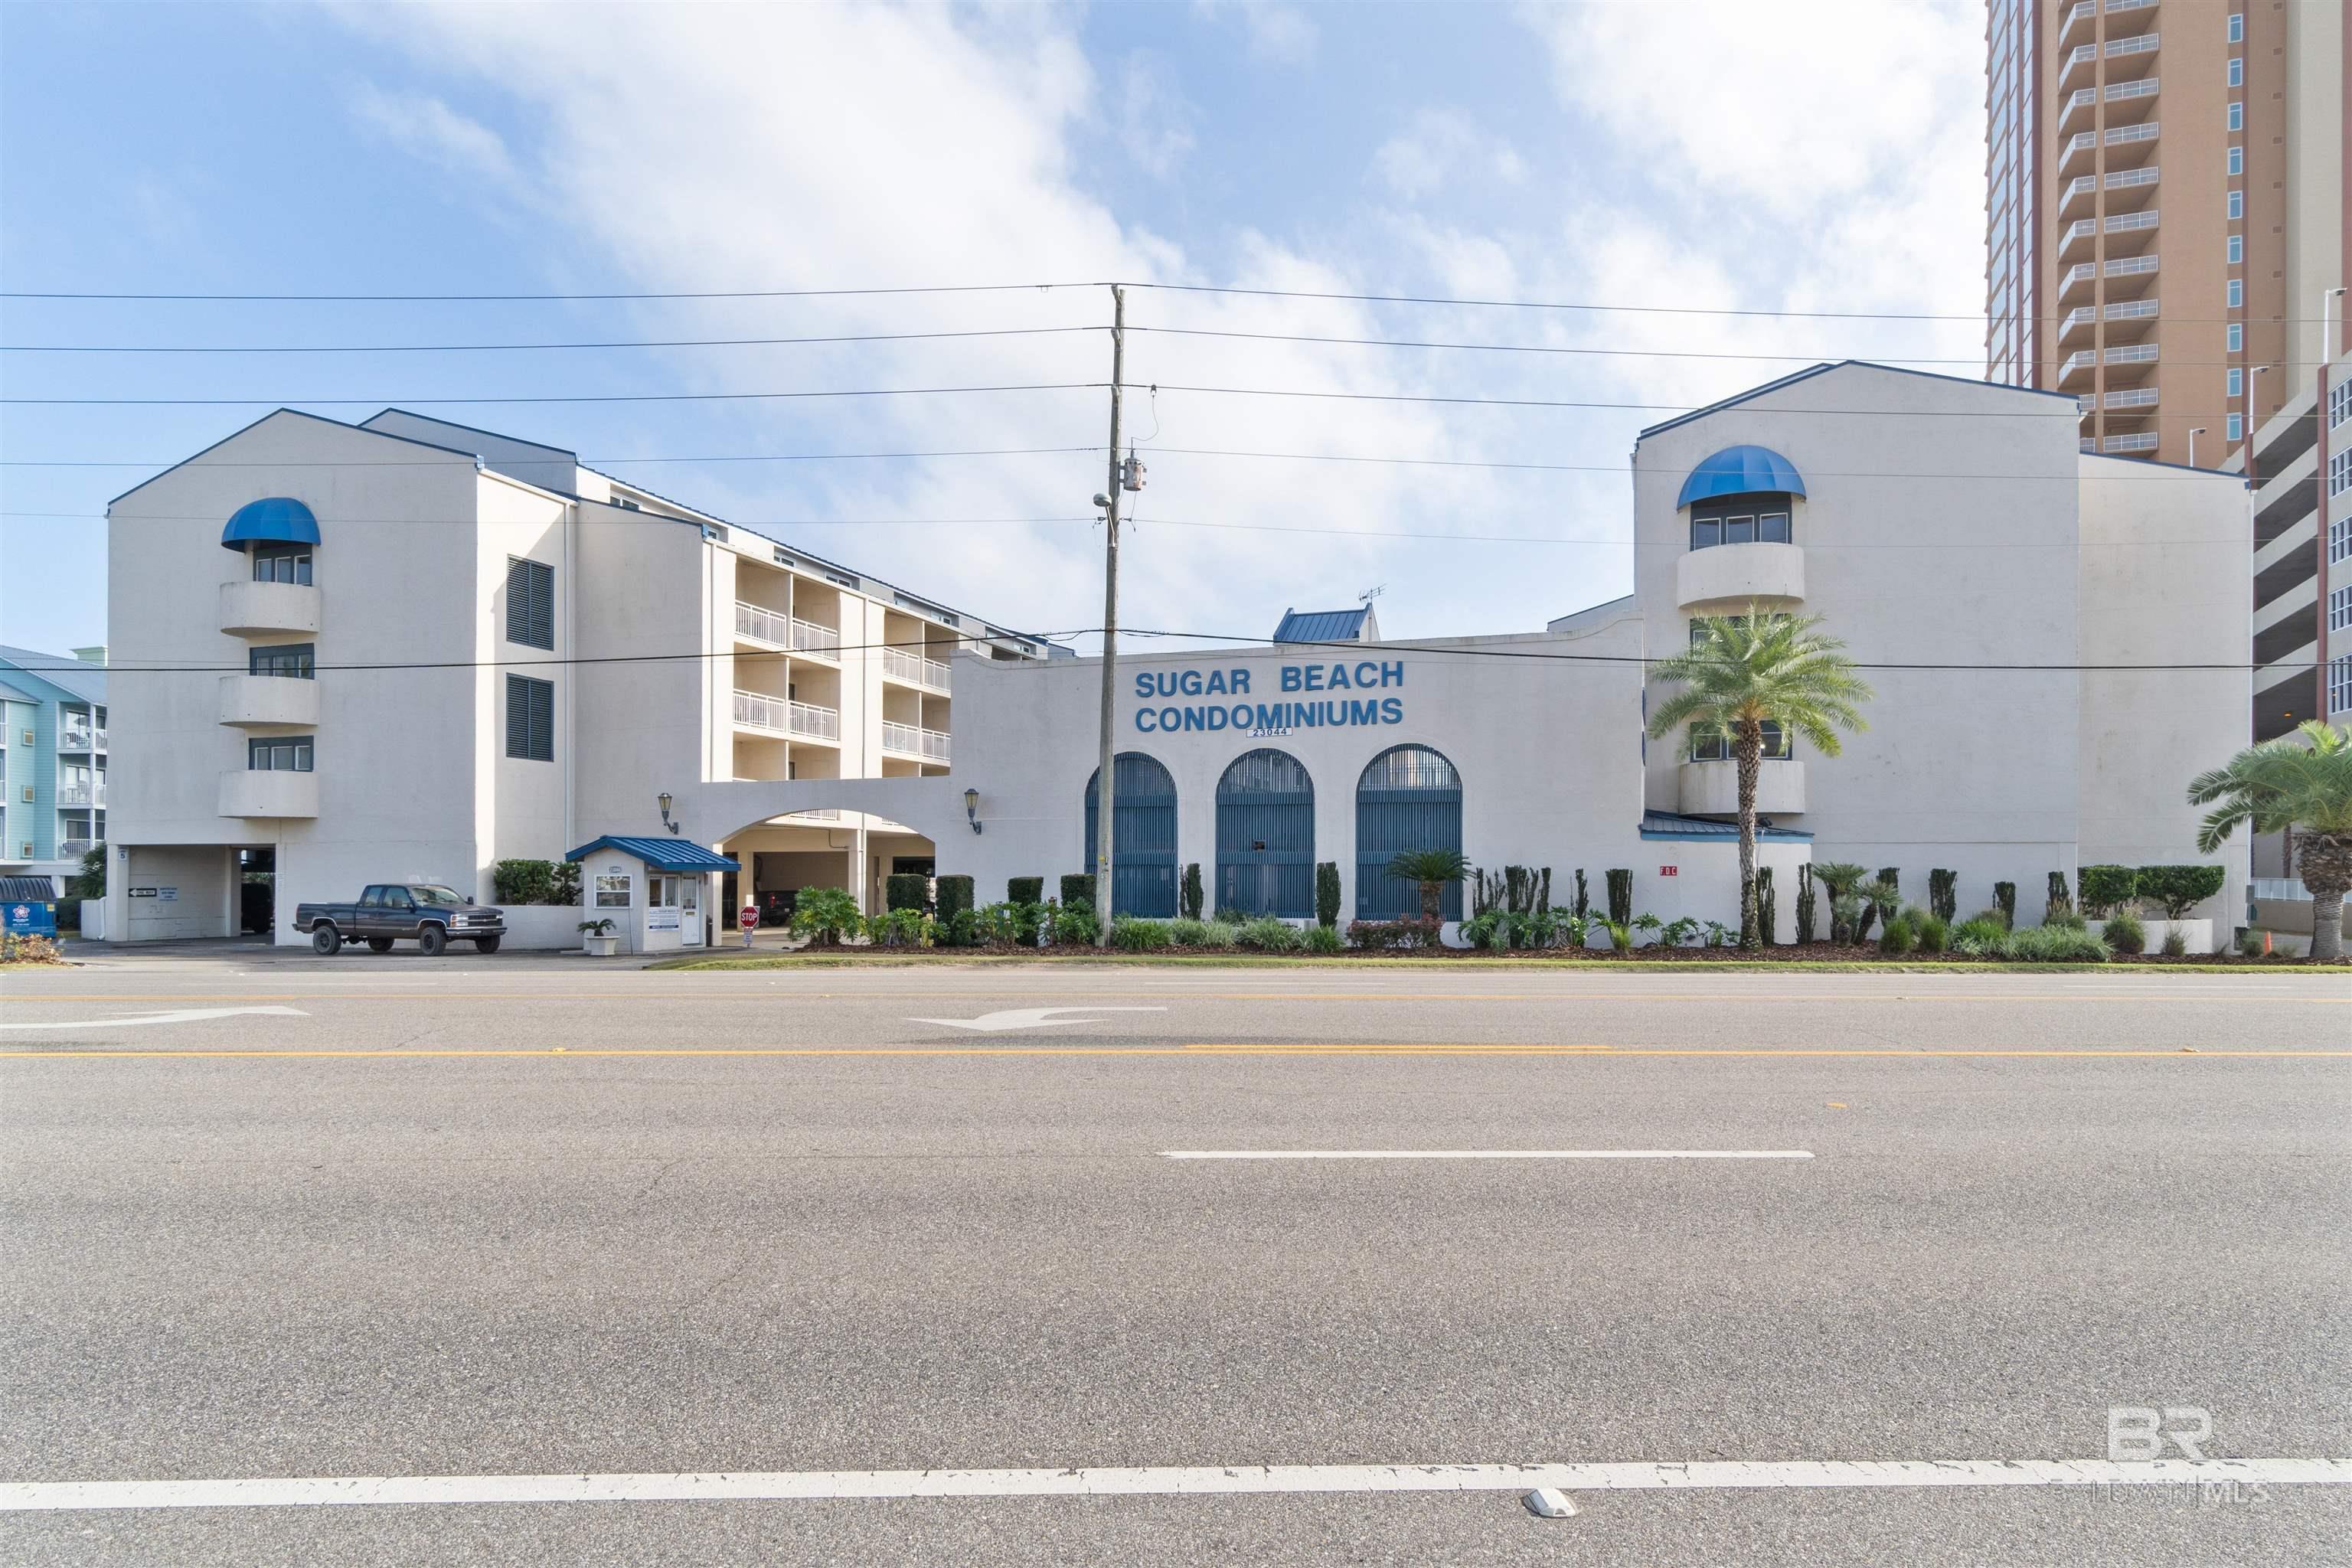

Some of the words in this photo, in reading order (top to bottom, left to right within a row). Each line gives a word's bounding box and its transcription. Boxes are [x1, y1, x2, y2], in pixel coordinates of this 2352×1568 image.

[1135, 668, 1250, 697] SUGAR
[1281, 661, 1404, 692] BEACH
[1135, 697, 1404, 733] CONDOMINIUMS
[1253, 728, 1287, 737] 23044
[741, 912, 757, 921] STOP
